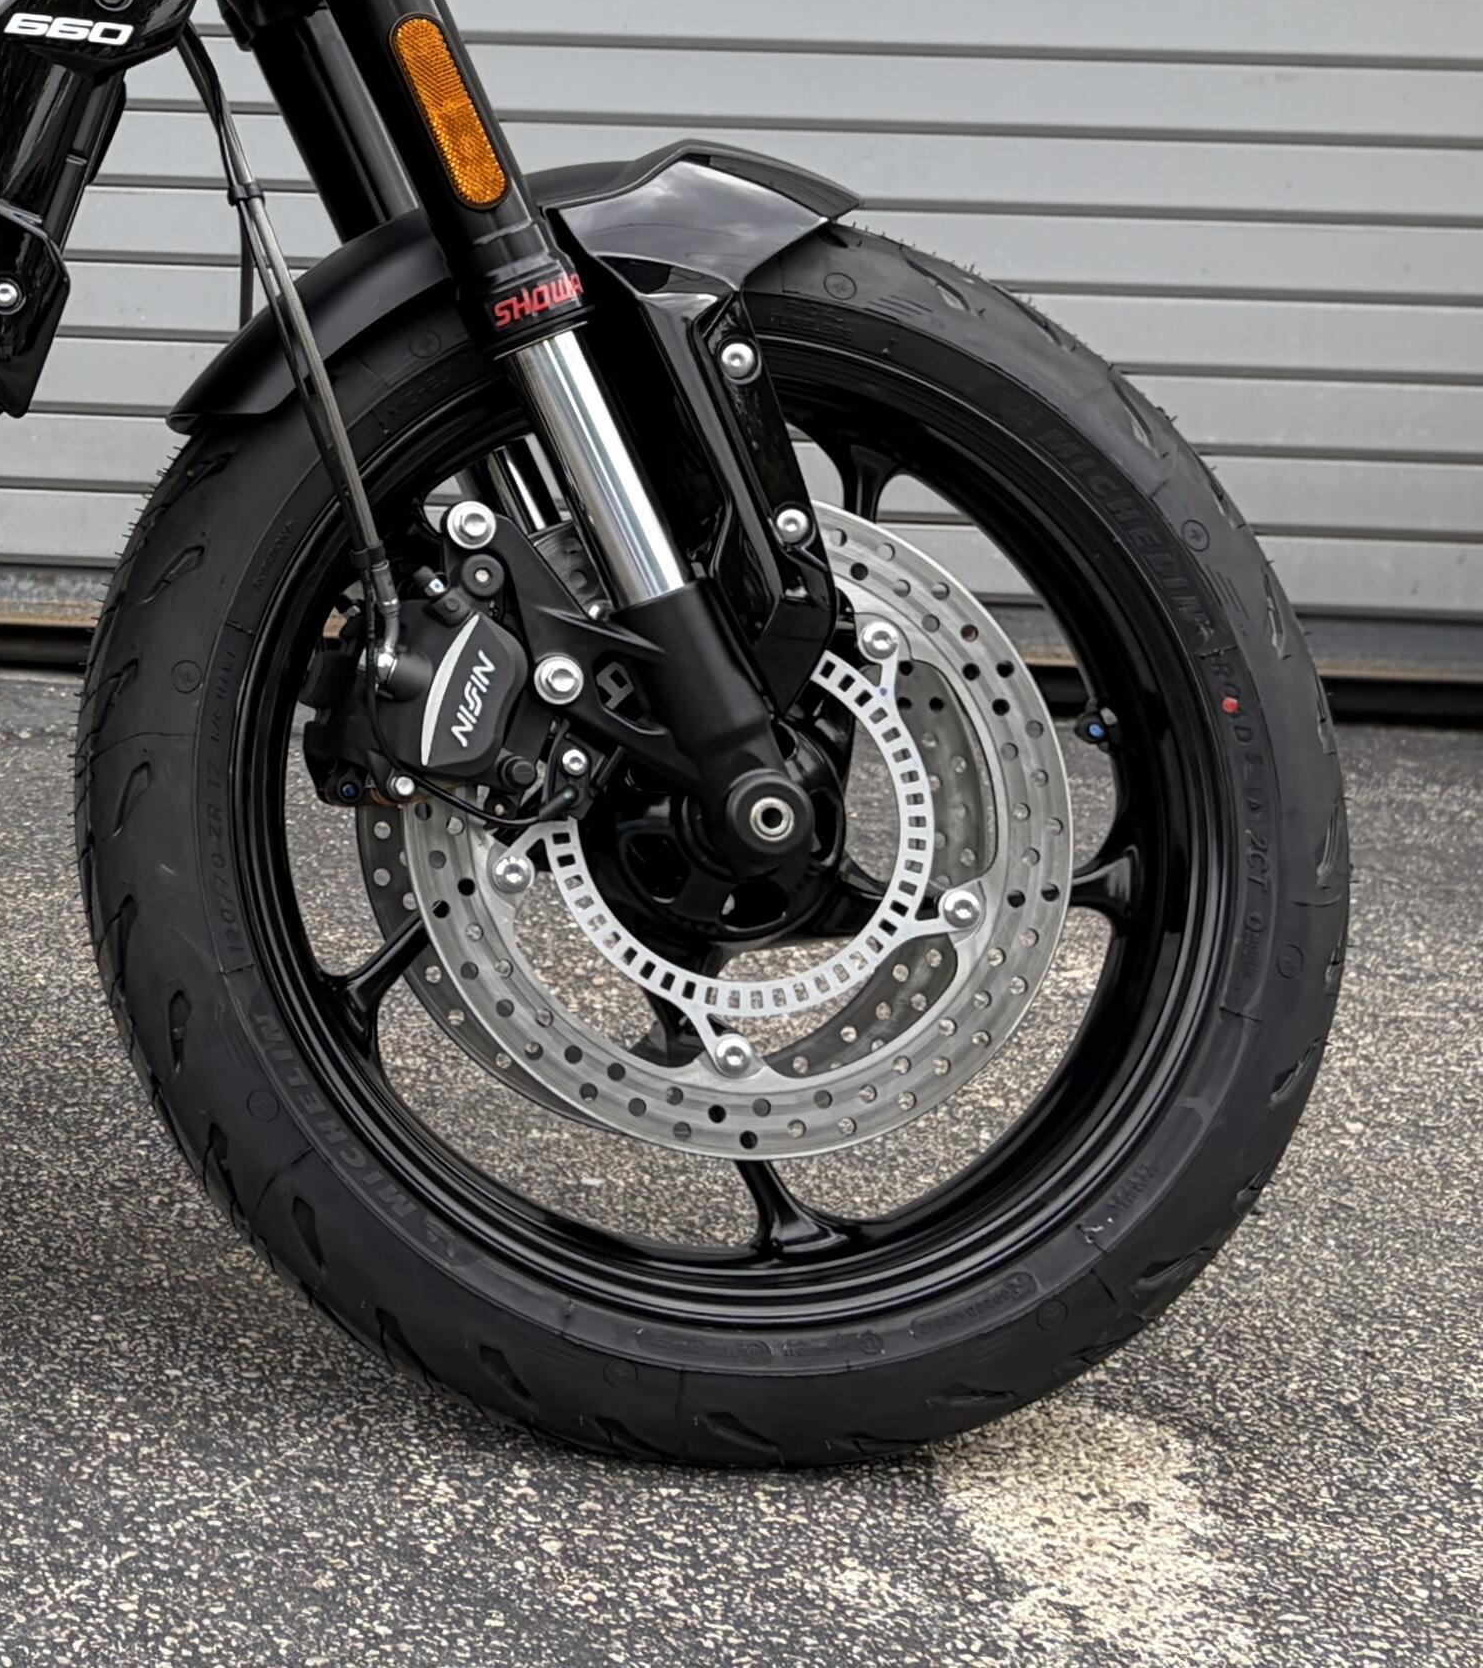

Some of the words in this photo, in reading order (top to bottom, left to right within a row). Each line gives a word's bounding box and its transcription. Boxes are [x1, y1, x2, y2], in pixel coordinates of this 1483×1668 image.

[3, 12, 134, 46] 660
[493, 272, 584, 331] SHOWA
[1032, 421, 1208, 626] MICHELIN
[450, 649, 497, 749] NISSIN
[250, 1008, 418, 1221] MICHELIN
